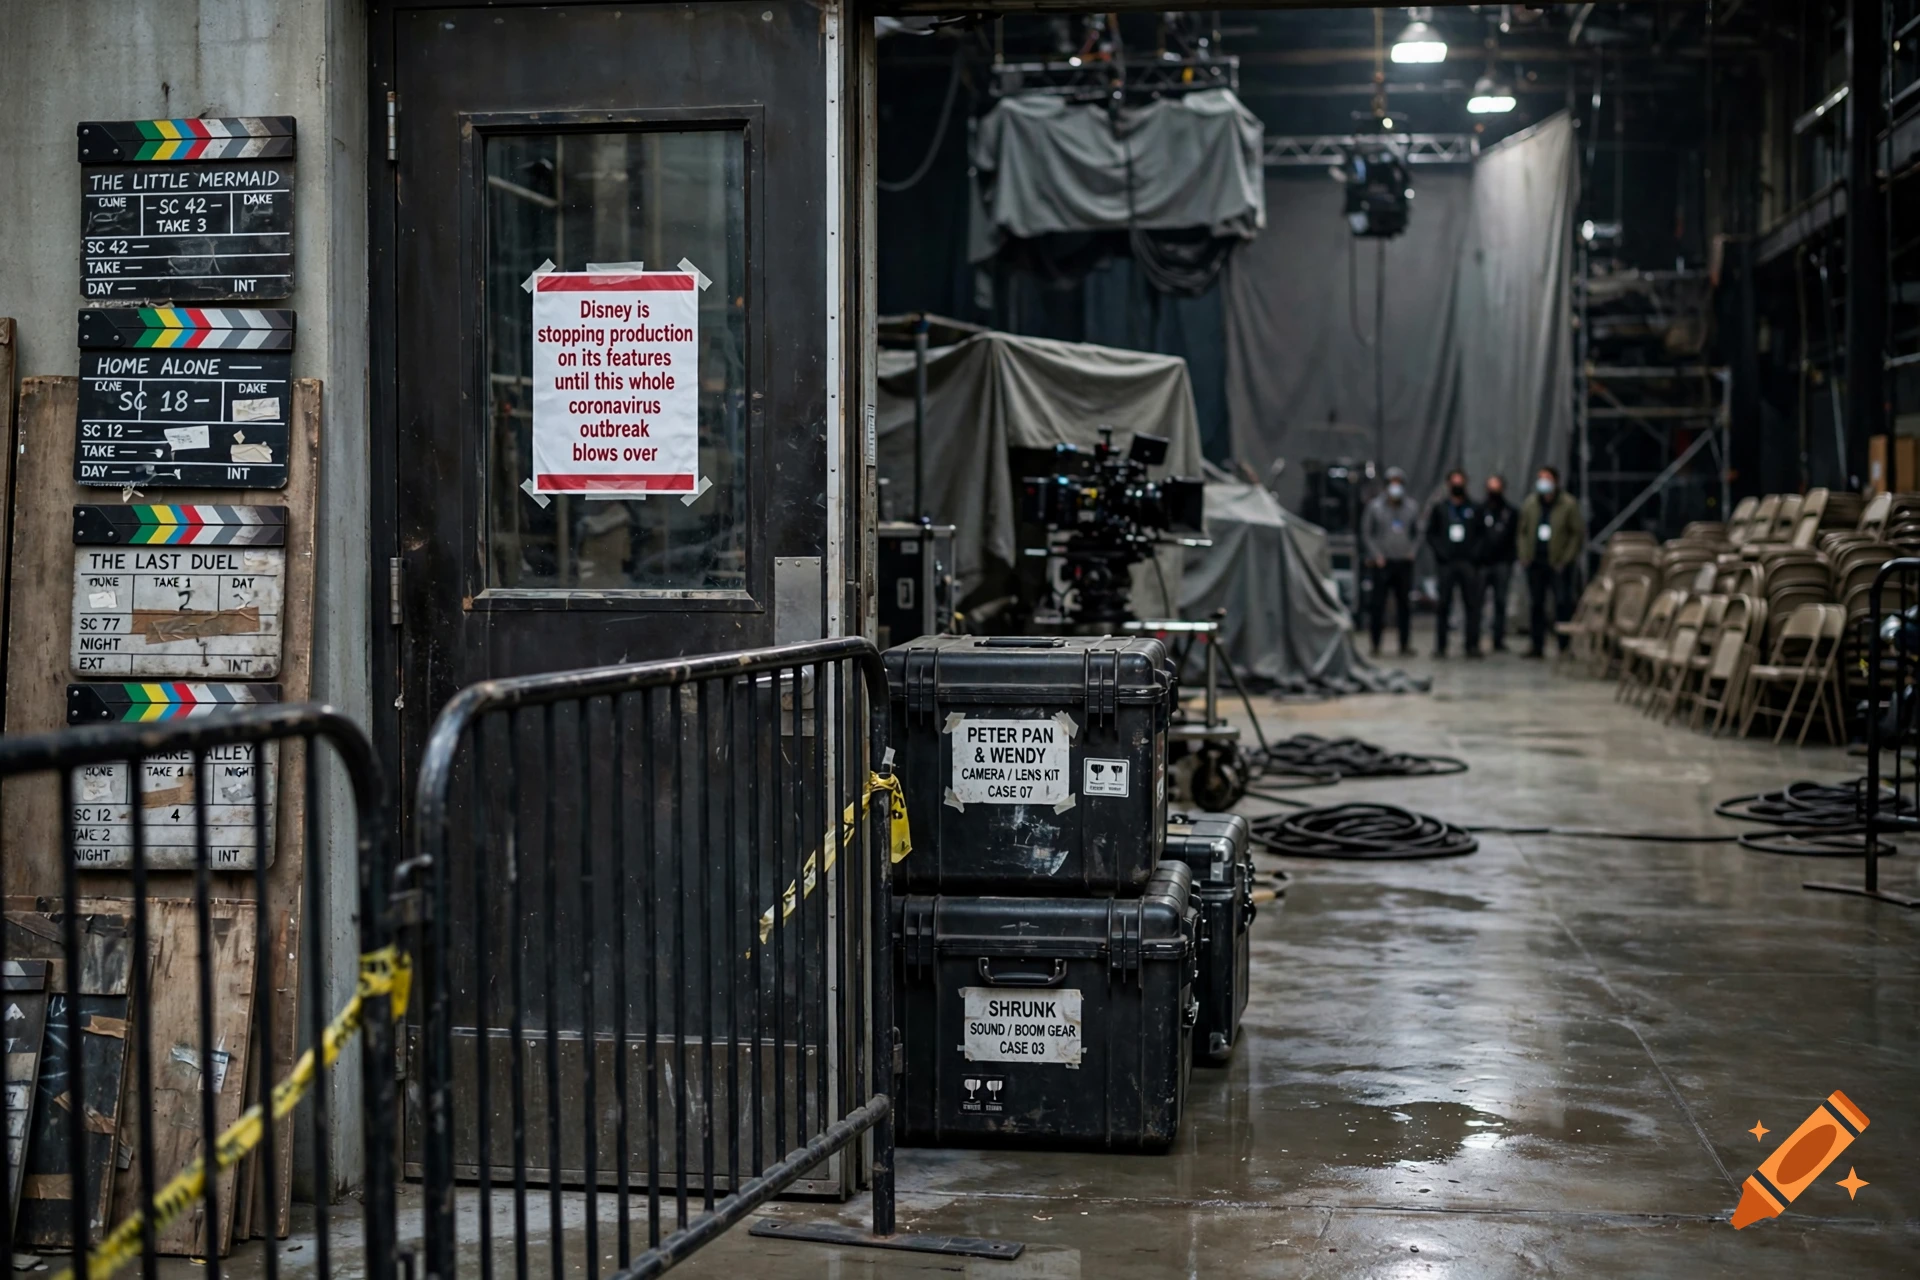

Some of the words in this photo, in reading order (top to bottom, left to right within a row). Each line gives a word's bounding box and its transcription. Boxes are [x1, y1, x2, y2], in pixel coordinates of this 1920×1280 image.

[90, 174, 124, 191] THE
[132, 172, 190, 190] LITTLE
[198, 170, 280, 187] MERMAID
[156, 219, 190, 233] TAKE
[197, 218, 207, 232] 3
[87, 241, 105, 254] SC
[109, 241, 128, 254] 42
[87, 261, 121, 274] TAKE
[87, 282, 114, 295] DAY
[233, 279, 257, 293] INT
[580, 300, 632, 322] Disney
[637, 300, 650, 318] is
[538, 324, 605, 347] stopping
[609, 324, 693, 347] production
[558, 352, 577, 367] on
[582, 348, 602, 367] its
[606, 348, 672, 367] features
[97, 357, 150, 375] HOME
[160, 357, 221, 376] ALONE
[555, 372, 590, 390] until
[594, 372, 624, 390] this
[629, 372, 675, 390] whole
[238, 383, 268, 394] DAKE
[118, 391, 148, 412] SC
[160, 390, 189, 412] 18
[569, 396, 661, 414] coronavirus
[83, 425, 101, 437] SC
[107, 424, 123, 437] 12
[580, 419, 650, 438] outbreak
[82, 445, 115, 458] TAKE
[573, 443, 618, 461] blows
[623, 447, 658, 461] over
[81, 466, 108, 478] DAY
[227, 467, 250, 480] INT
[89, 553, 125, 570] THE
[135, 553, 182, 570] LAST
[191, 554, 239, 570] DUEL
[153, 577, 179, 588] TAKE
[185, 577, 191, 588] 1
[80, 618, 98, 631] SC
[102, 617, 121, 631] 77
[80, 637, 121, 651] NIGHT
[79, 657, 105, 670] EXT
[228, 659, 253, 672] INT
[967, 727, 1017, 743] PETER
[1022, 727, 1054, 744] PAN
[204, 745, 255, 760] ALLEY
[974, 747, 985, 763] &
[990, 747, 1046, 764] WENDY
[146, 766, 173, 777] TAKE
[224, 766, 256, 778] NGHT
[961, 768, 1005, 780] CAMERA
[1015, 769, 1042, 781] LENS
[1044, 769, 1060, 781] KIT
[988, 785, 1017, 798] CASE
[1020, 786, 1033, 798] 07
[74, 808, 92, 822] SC
[97, 808, 113, 822] 12
[170, 808, 181, 822] 4
[102, 828, 111, 842] 2
[72, 848, 111, 862] NIGHT
[218, 849, 240, 862] INT
[988, 1000, 1057, 1018] SHRUNK
[970, 1022, 1005, 1036] SOUND
[1014, 1024, 1045, 1037] BOOM
[1047, 1025, 1076, 1037] GEAR
[999, 1041, 1029, 1054] CASE
[1031, 1042, 1045, 1055] 03
